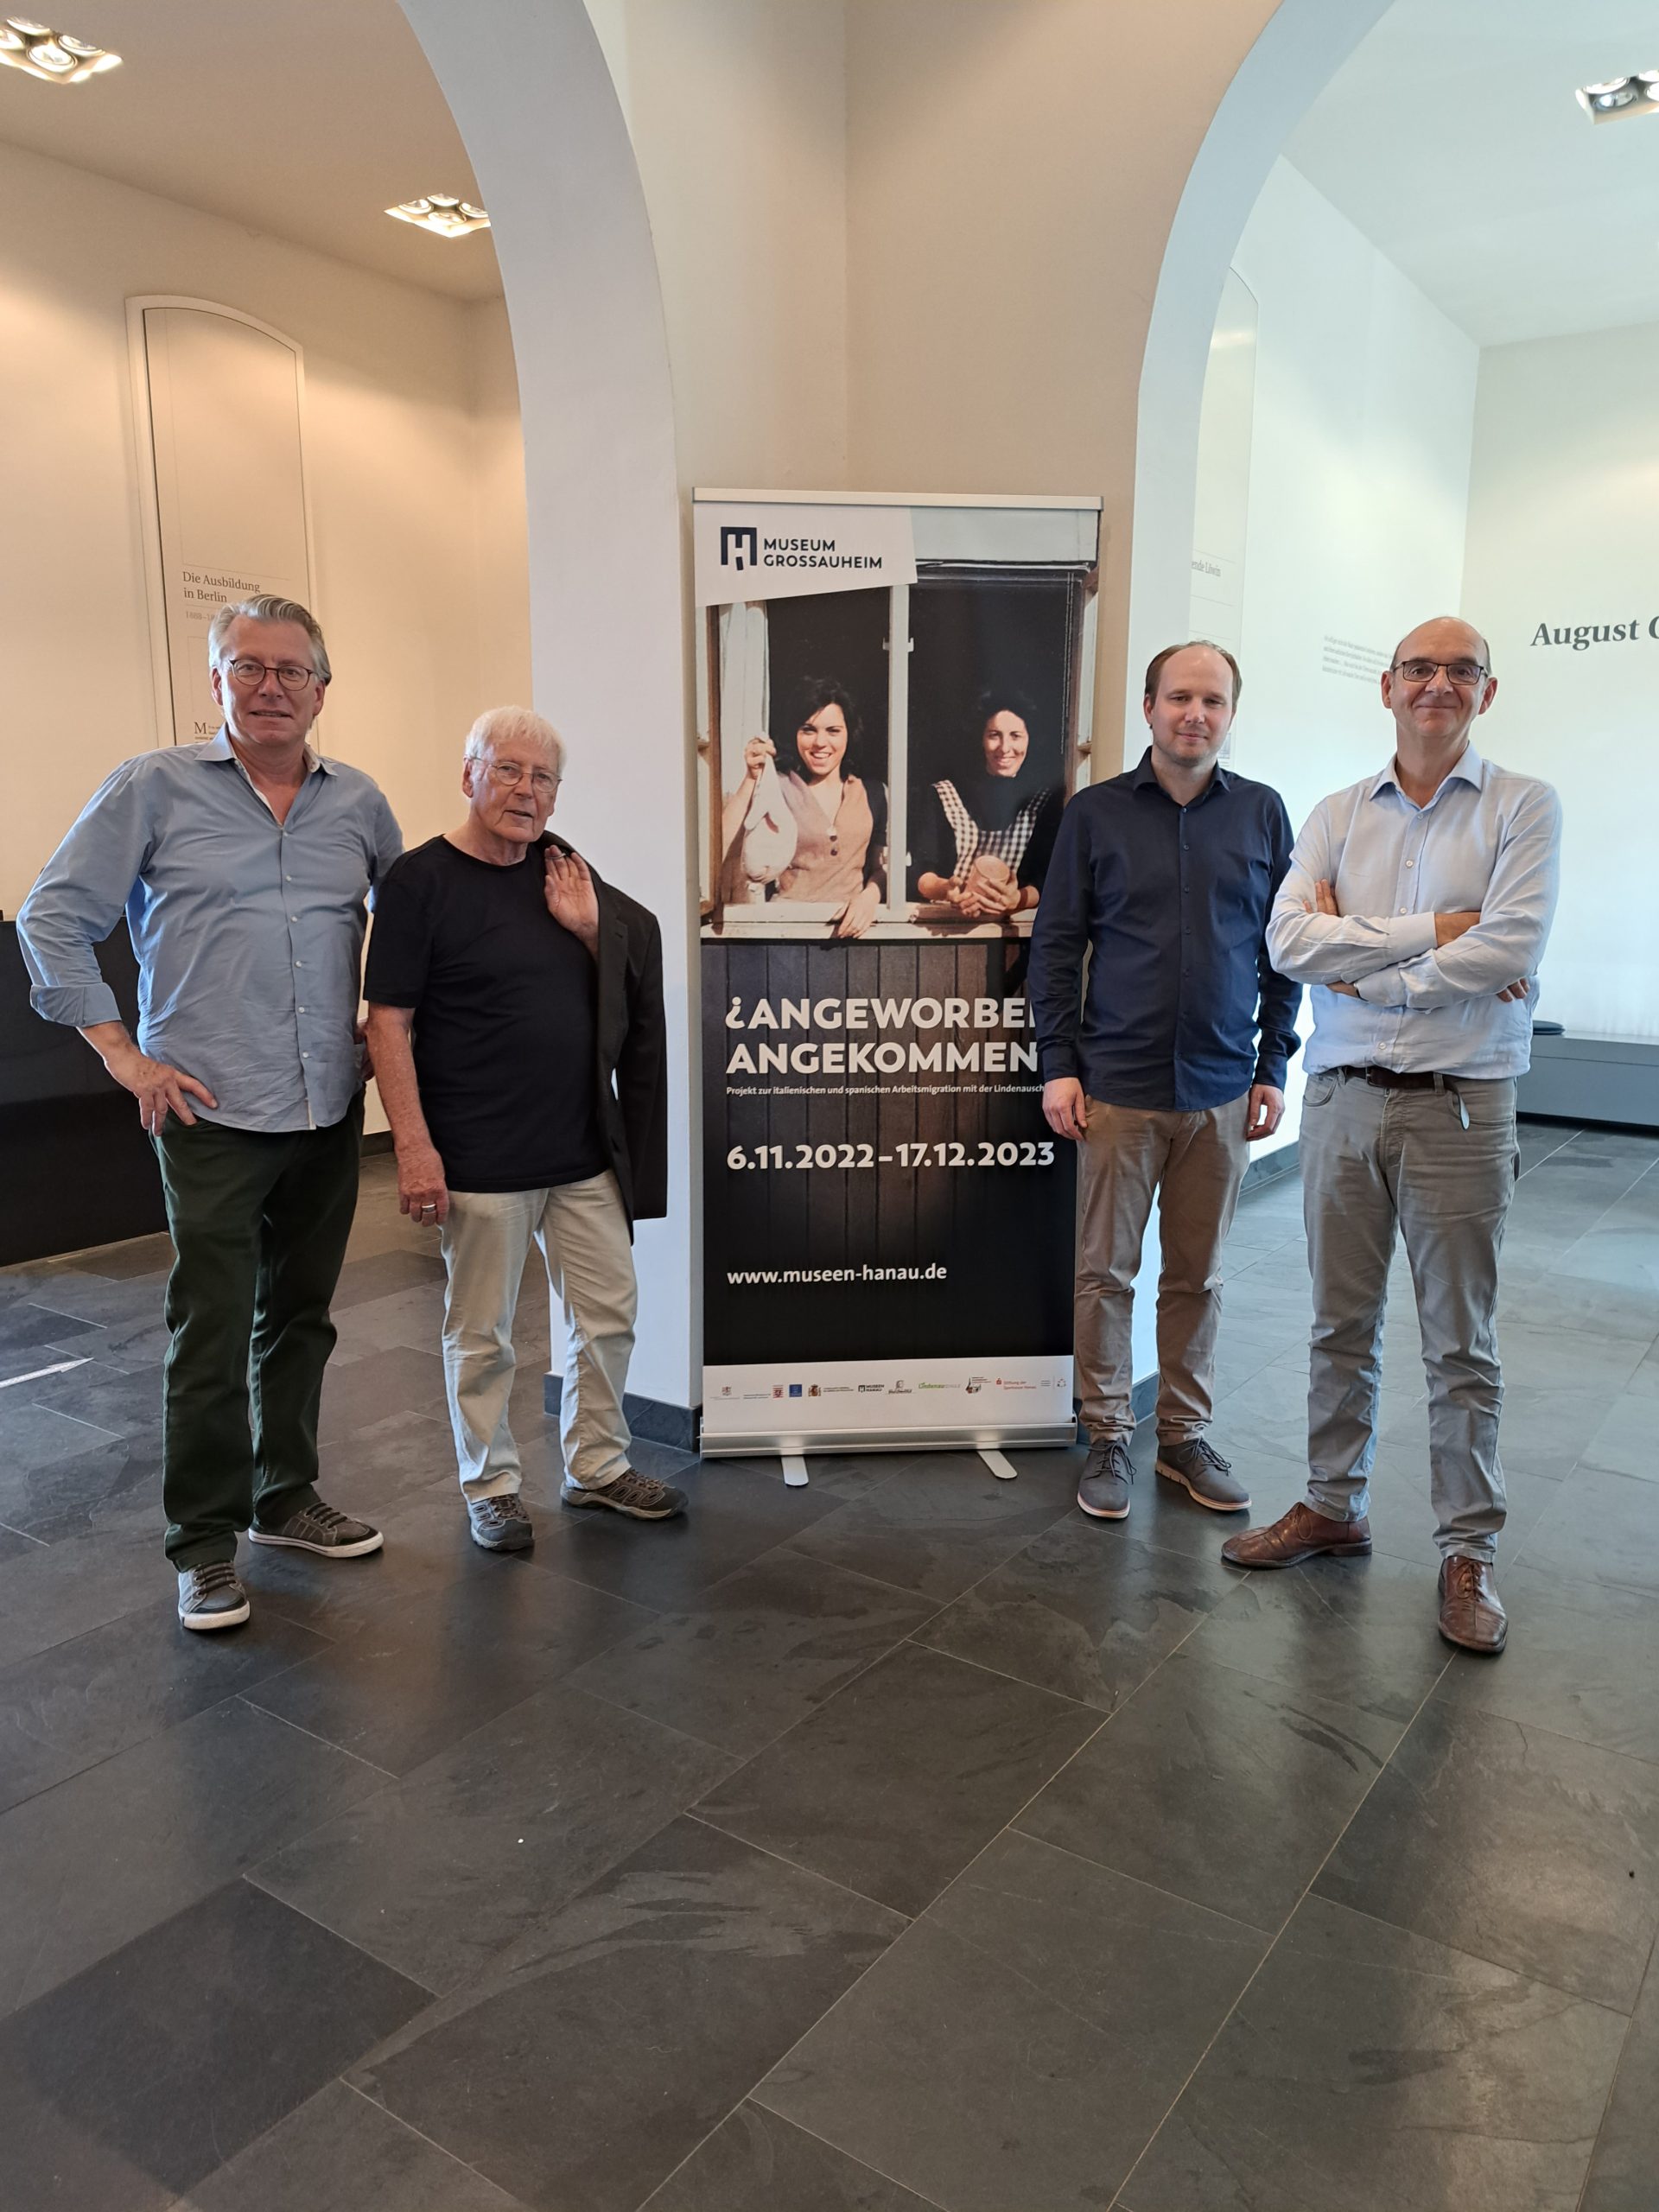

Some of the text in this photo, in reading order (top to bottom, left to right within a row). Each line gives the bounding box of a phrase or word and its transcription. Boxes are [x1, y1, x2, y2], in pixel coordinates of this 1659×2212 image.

[763, 538, 836, 551] MUSEUM
[763, 554, 882, 569] GROSSAUHEIM
[182, 571, 261, 594] Die Ausbildung
[184, 588, 227, 603] in Berlin
[1529, 619, 1640, 652] August
[726, 1041, 1038, 1074] ANGEKOMMEN
[726, 1086, 757, 1096] Projekt
[772, 1085, 826, 1095] italienischen
[827, 1085, 844, 1094] und
[845, 1085, 891, 1096] spanischen
[892, 1084, 962, 1095] Arbeitsmigration
[963, 1084, 977, 1093] mit
[978, 1084, 993, 1093] der
[727, 1262, 947, 1284] www.museen-hanau.de
